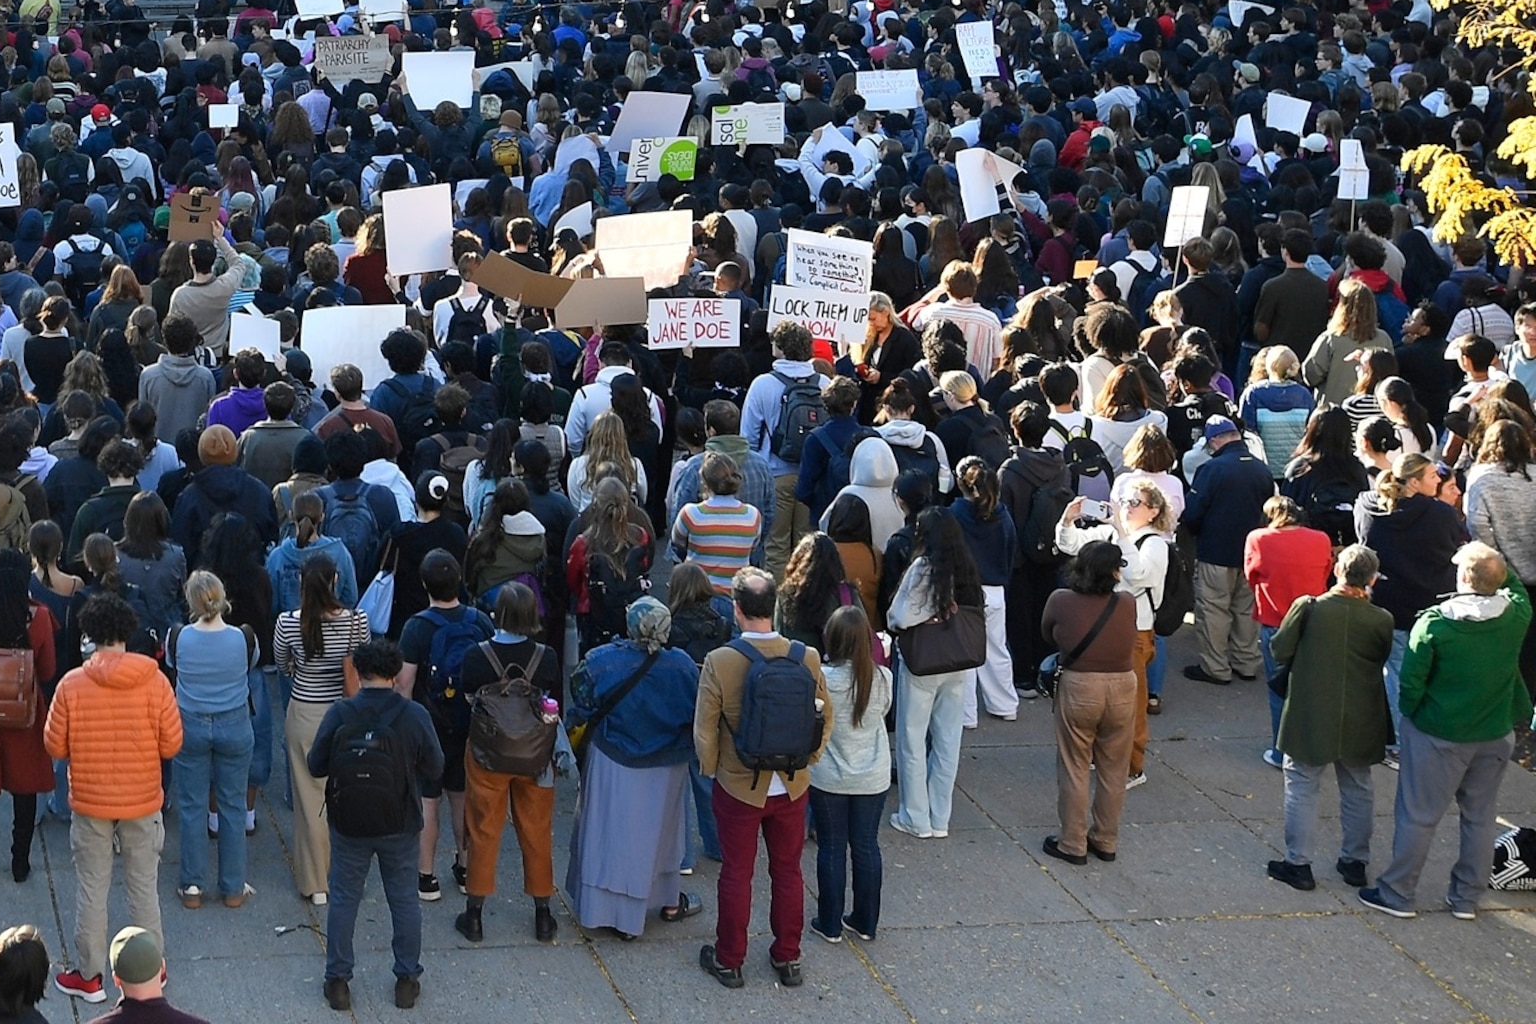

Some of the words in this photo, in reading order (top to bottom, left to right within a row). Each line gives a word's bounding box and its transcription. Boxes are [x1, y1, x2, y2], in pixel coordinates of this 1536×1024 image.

[318, 38, 371, 52] PATRIARCHY
[325, 52, 370, 66] PARASITE
[715, 119, 734, 145] sal
[796, 256, 815, 265] hear
[832, 252, 847, 261] see
[665, 301, 688, 319] WE
[692, 300, 723, 318] ARE
[773, 297, 810, 318] LOCK
[814, 300, 849, 322] THEM
[853, 308, 868, 324] UP
[653, 322, 688, 344] JANE
[694, 321, 731, 340] DOE
[802, 319, 836, 337] NOW
